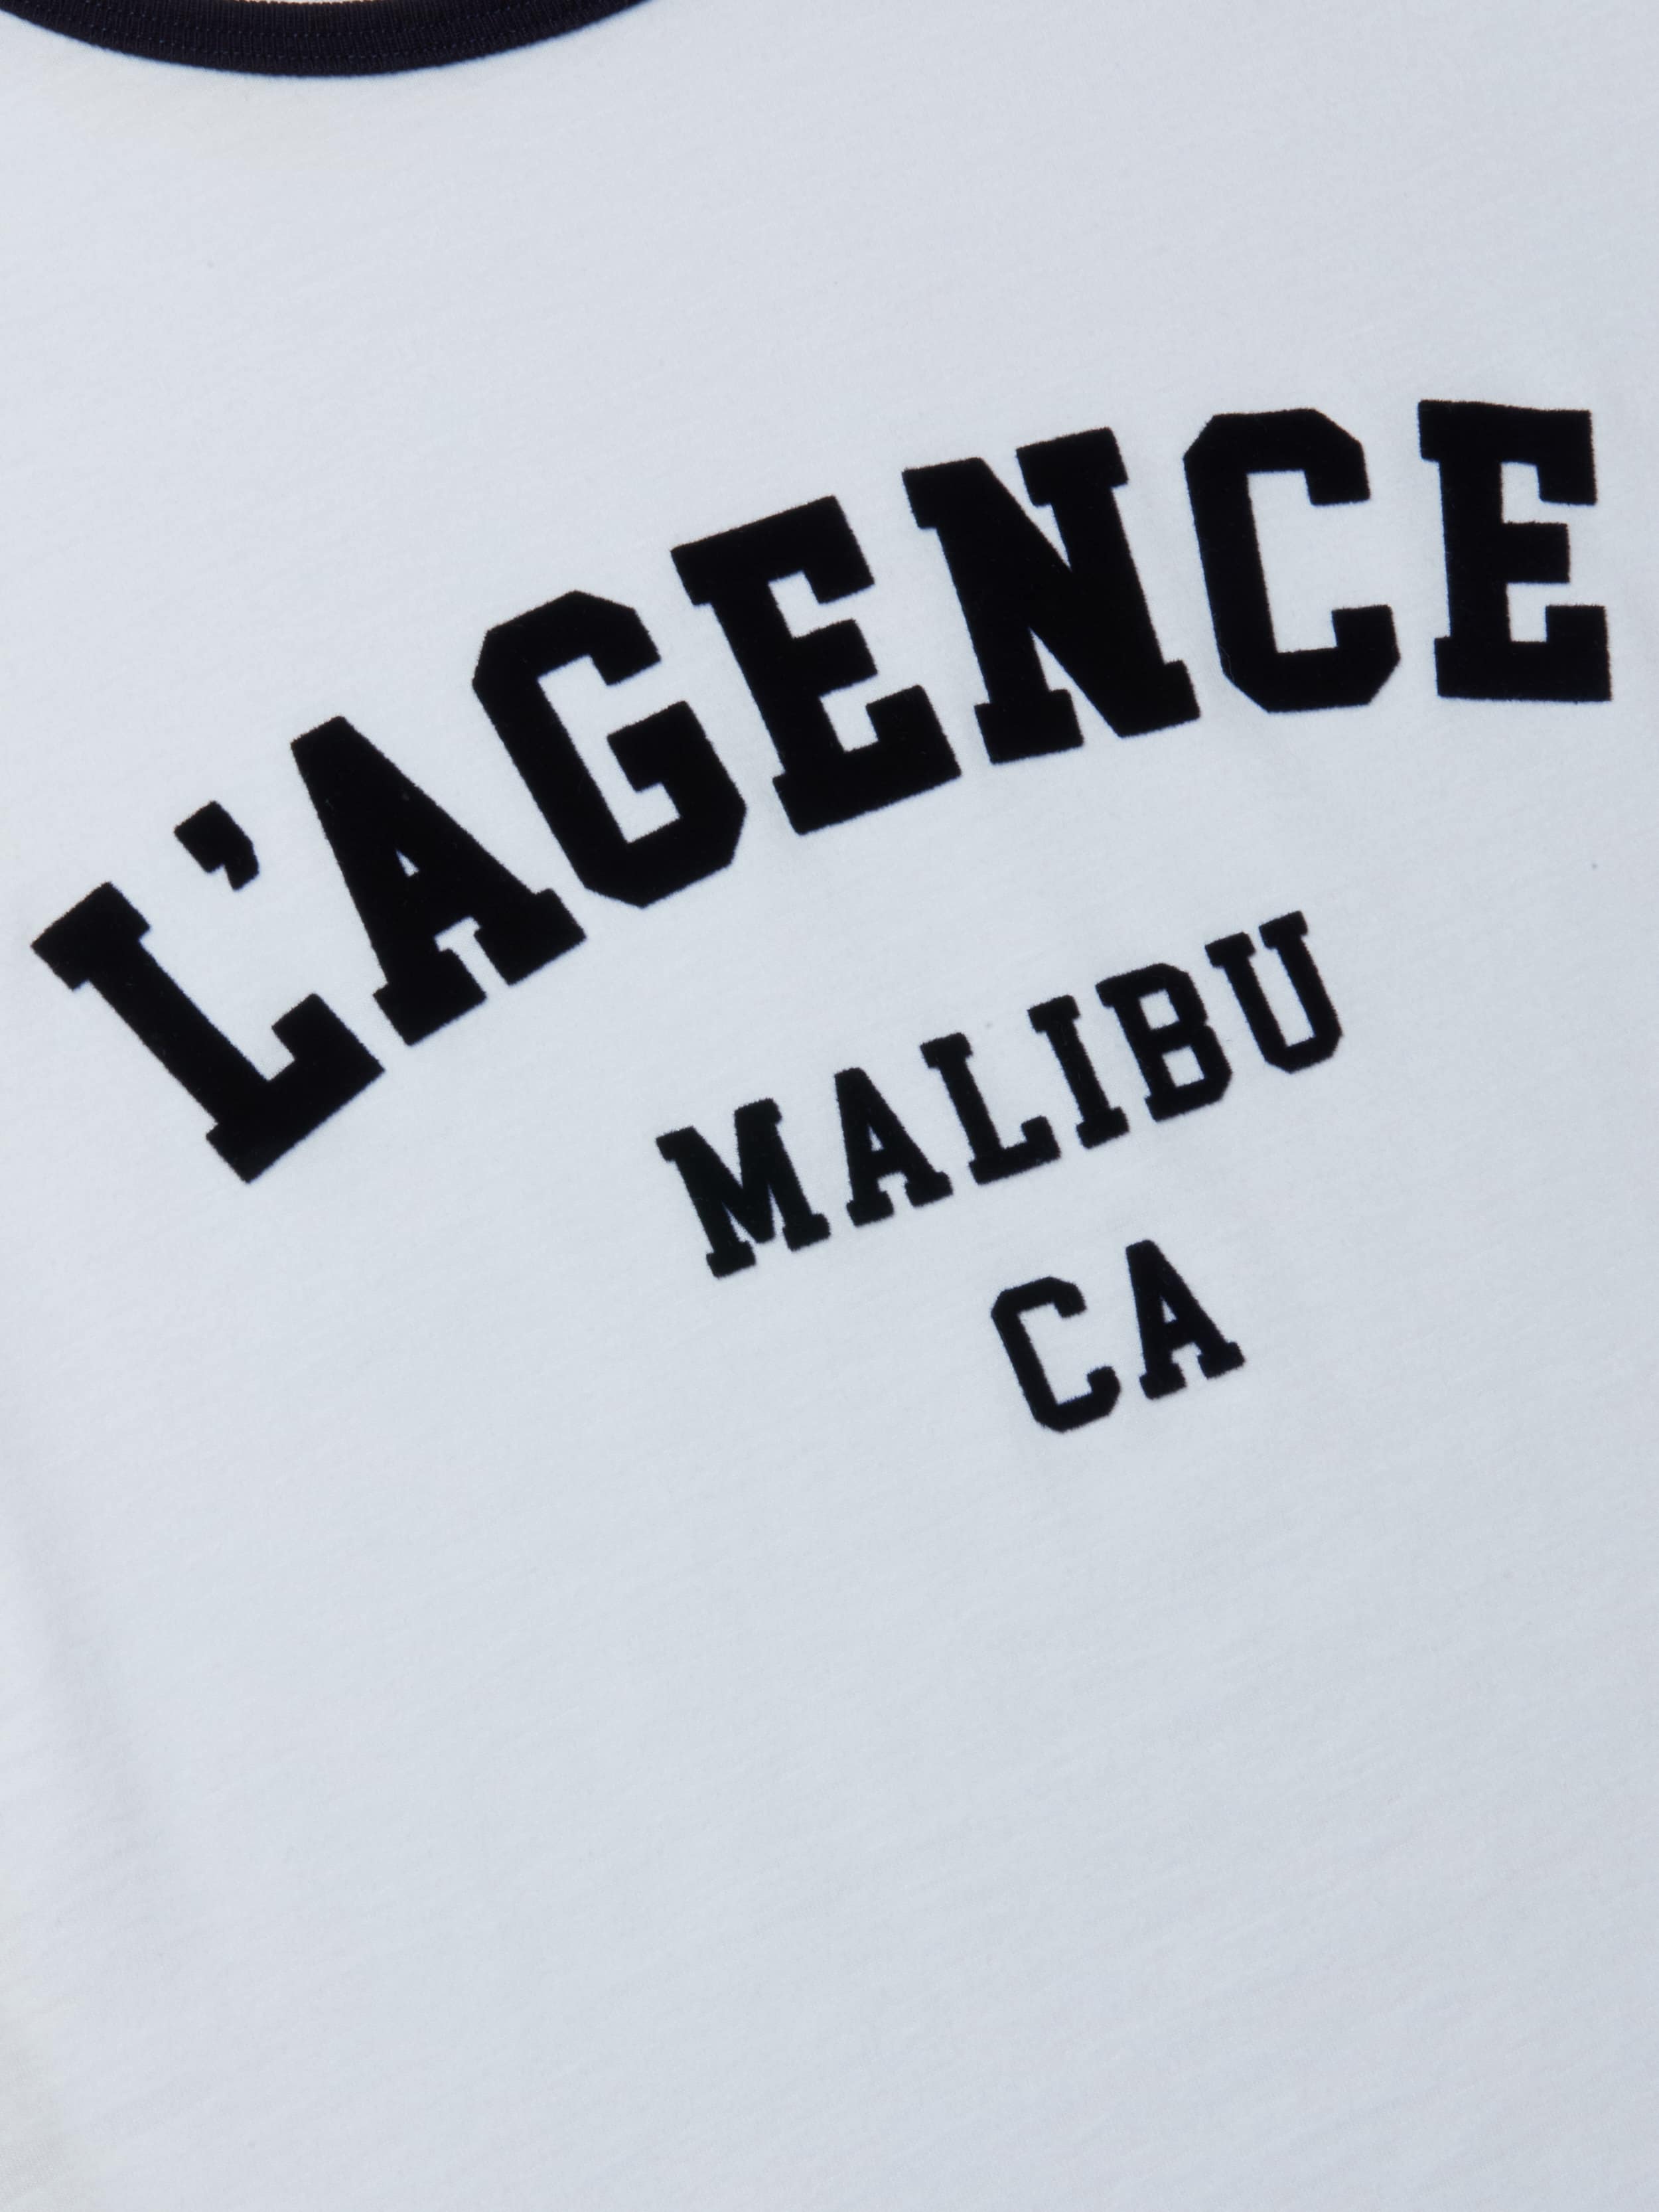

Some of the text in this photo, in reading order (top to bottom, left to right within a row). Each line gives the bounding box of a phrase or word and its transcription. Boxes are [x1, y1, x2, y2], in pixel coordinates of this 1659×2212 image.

[31, 400, 1612, 1183] L'AGENCE
[656, 911, 1343, 1279] MALIBU
[991, 1240, 1246, 1434] CA
